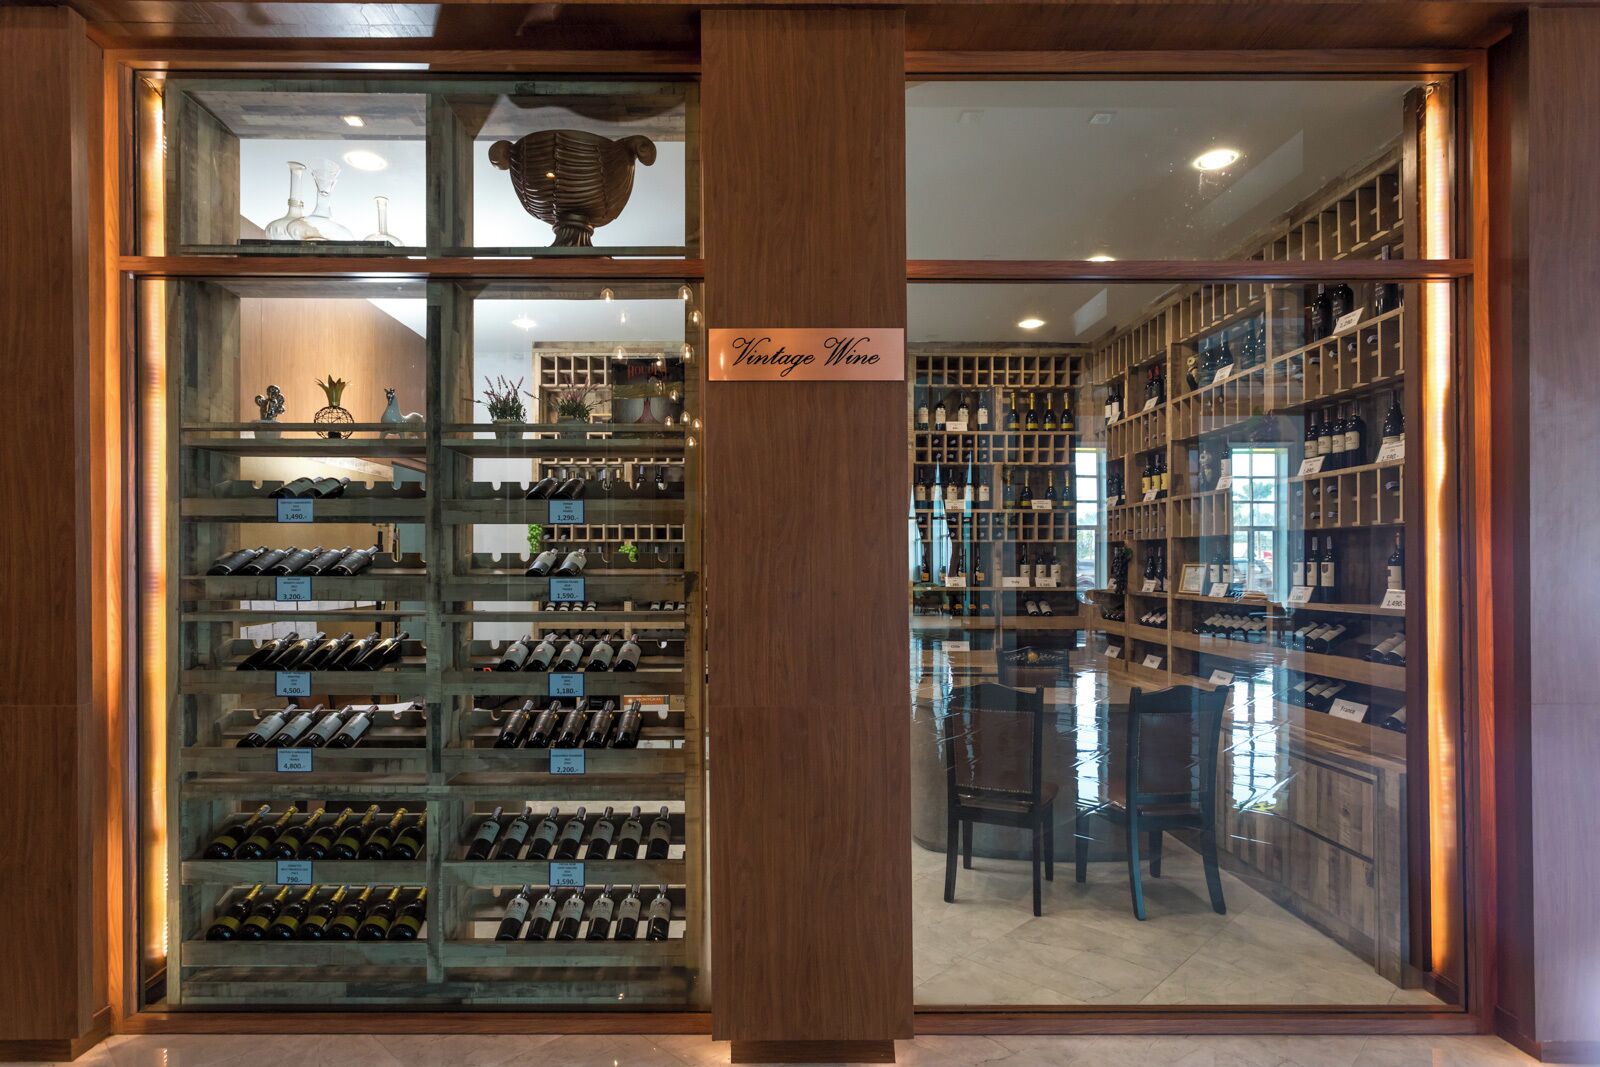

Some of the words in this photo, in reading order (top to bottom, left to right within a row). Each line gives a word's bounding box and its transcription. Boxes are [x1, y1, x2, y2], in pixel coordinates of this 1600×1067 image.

[732, 337, 815, 377] Vintage
[823, 337, 881, 366] Wine
[286, 513, 307, 521] 1,490.-
[557, 514, 580, 522] 1,290.-
[282, 687, 305, 695] 4,500.-
[556, 687, 580, 695] 1,180.-
[1339, 705, 1356, 715] France
[556, 766, 580, 774] 2,200.-
